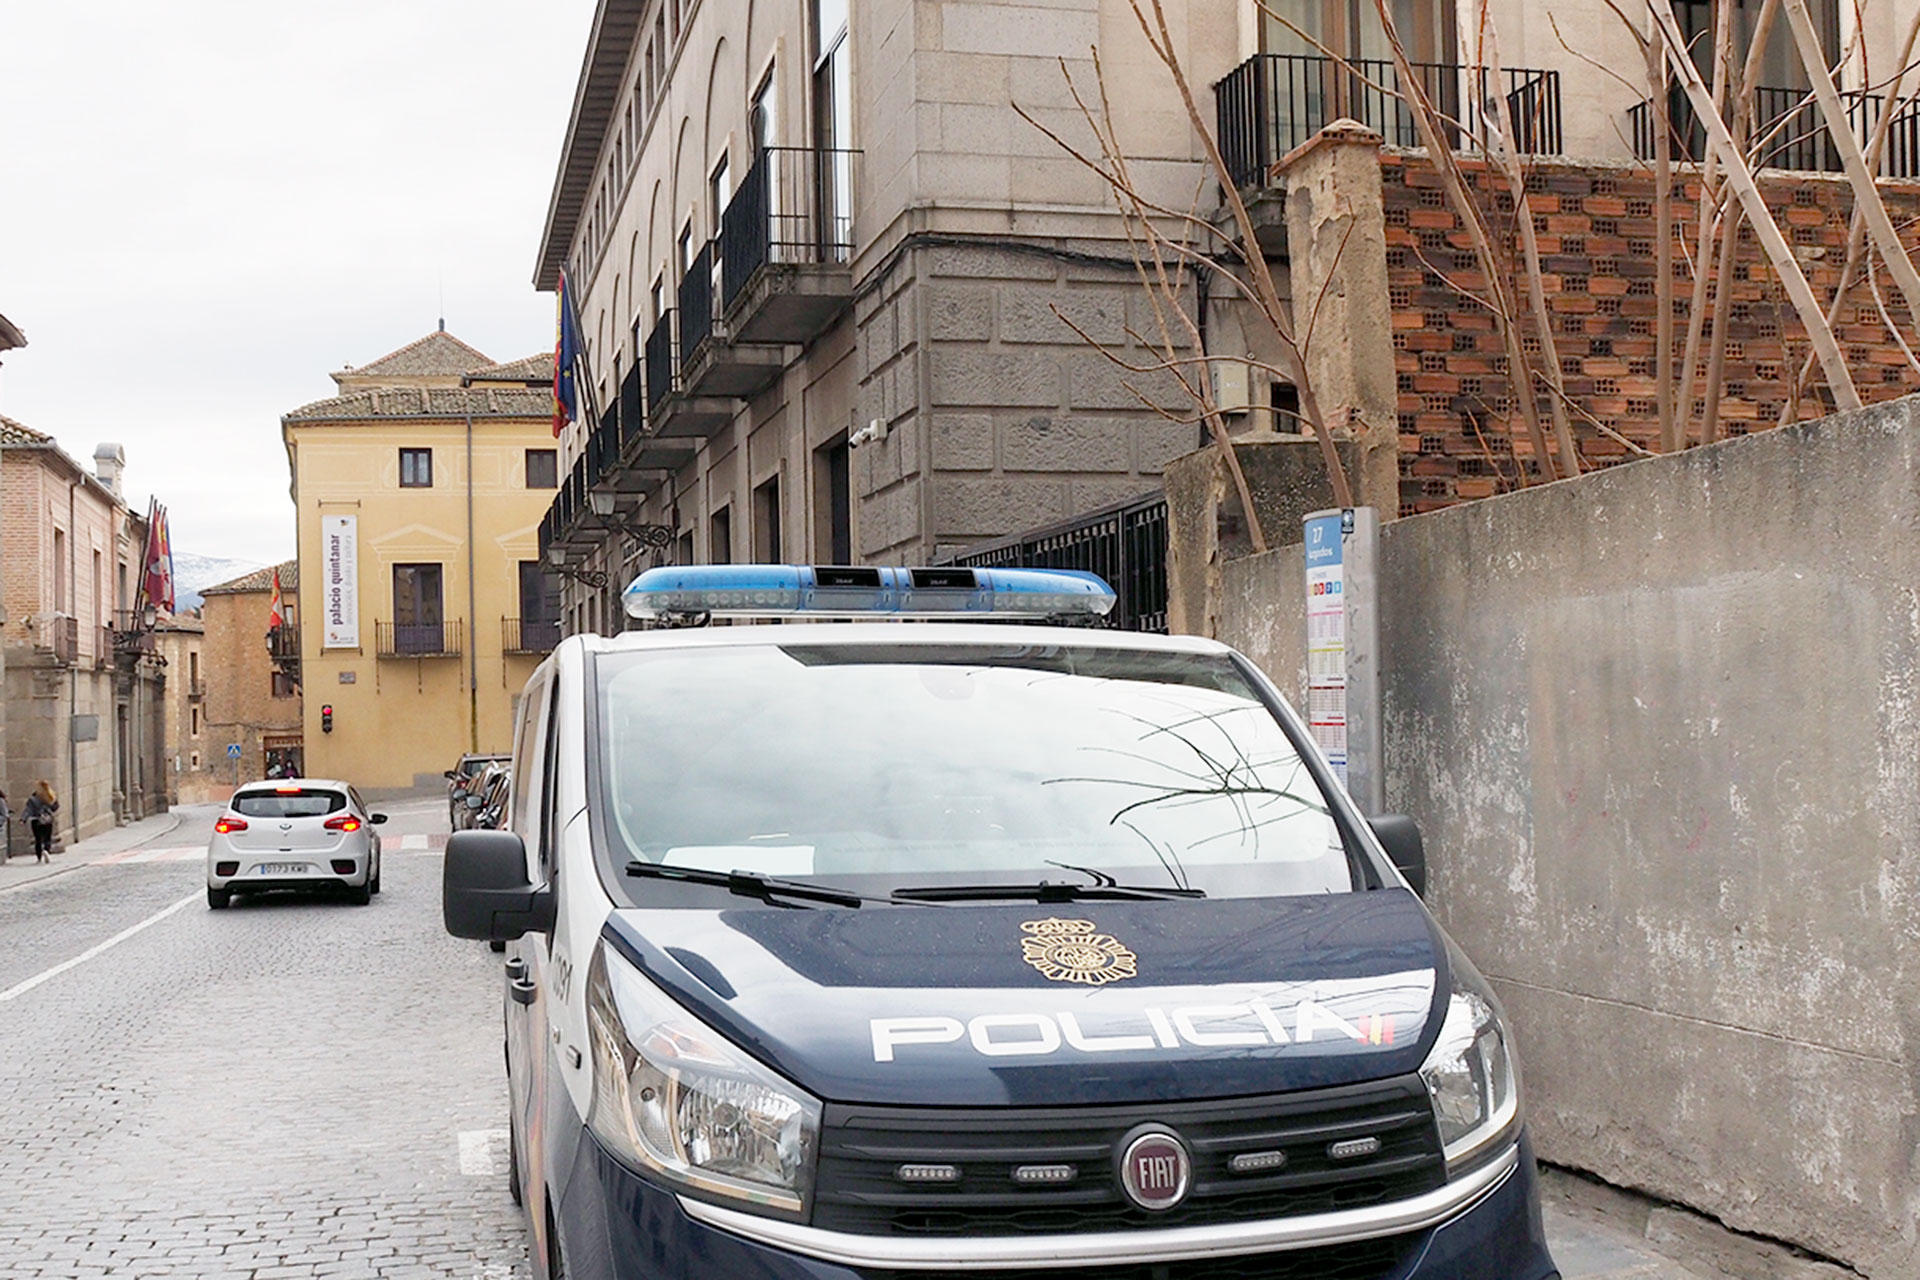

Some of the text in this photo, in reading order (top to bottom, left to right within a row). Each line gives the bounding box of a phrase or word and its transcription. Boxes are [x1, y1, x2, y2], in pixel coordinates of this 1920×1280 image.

[1313, 526, 1323, 544] 27
[328, 534, 343, 585] quintanar
[329, 587, 344, 625] palacio
[1138, 1156, 1176, 1189] FIAT
